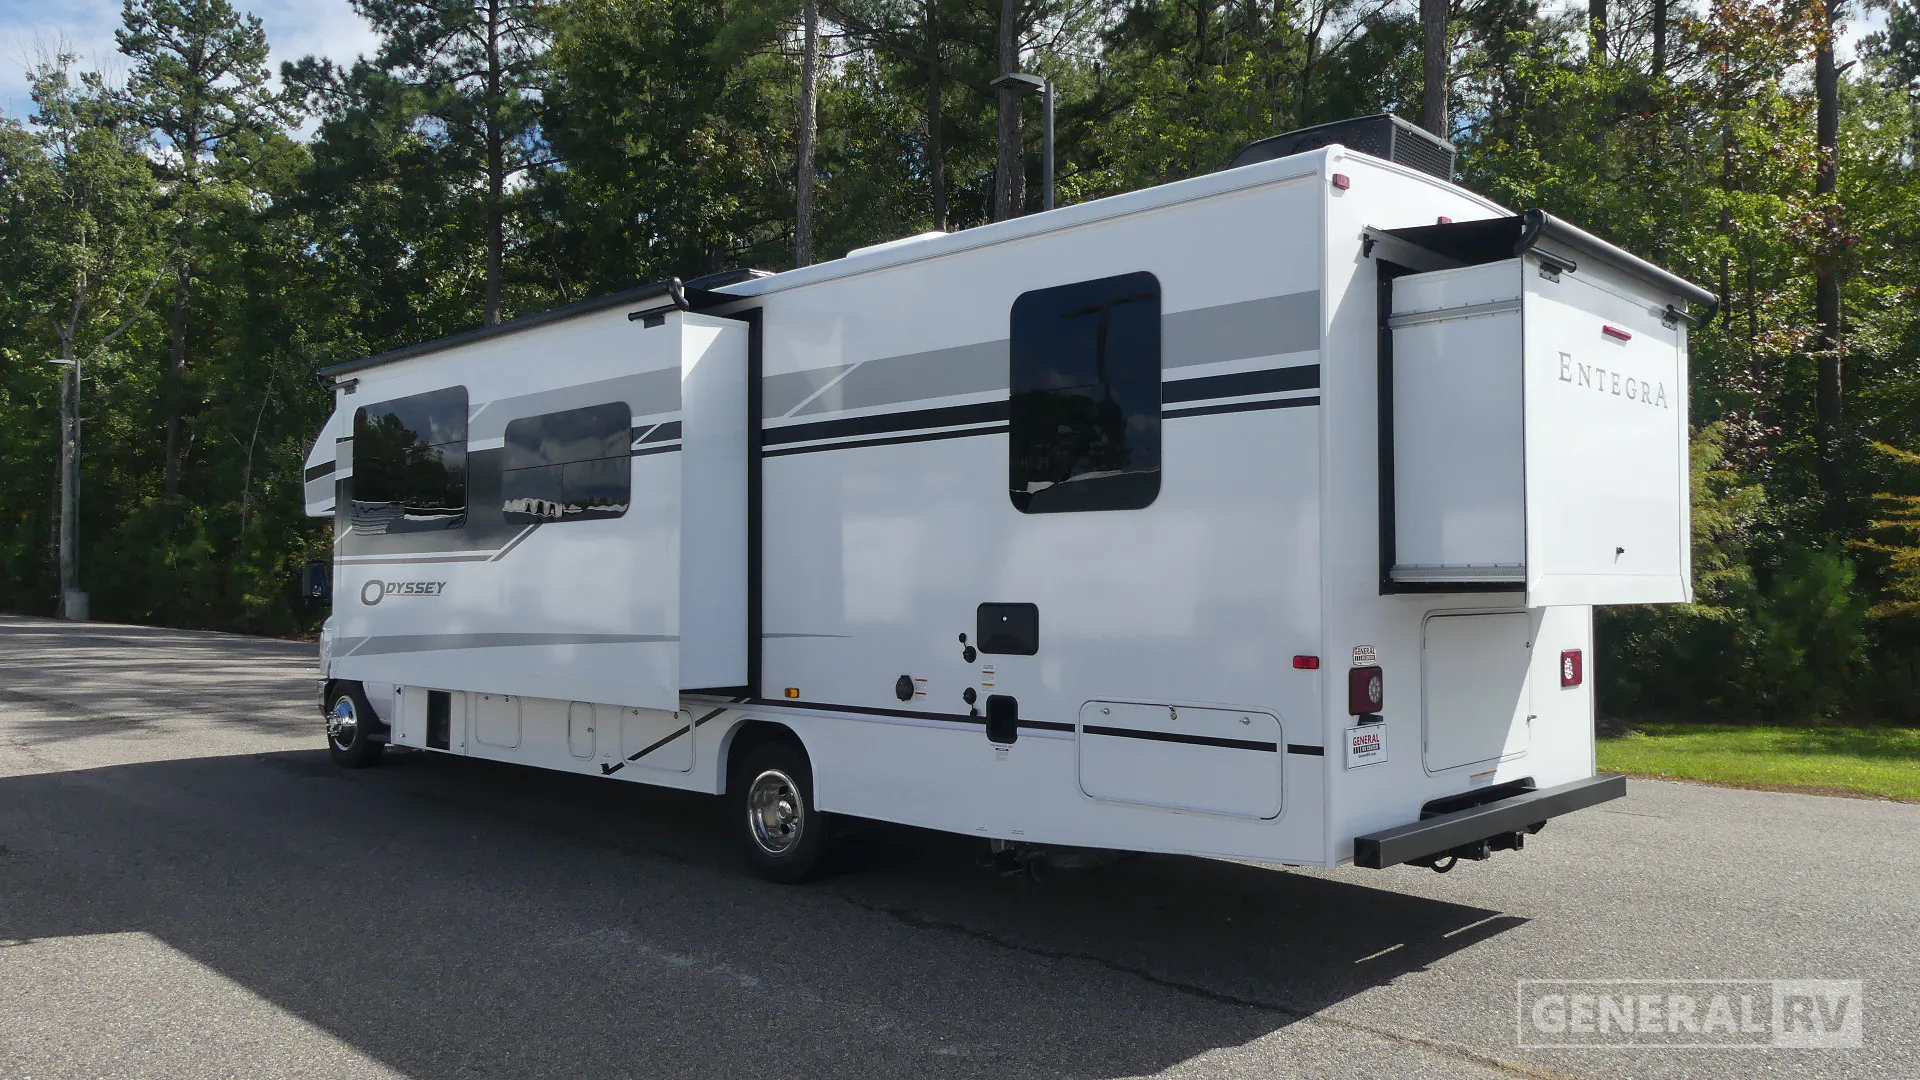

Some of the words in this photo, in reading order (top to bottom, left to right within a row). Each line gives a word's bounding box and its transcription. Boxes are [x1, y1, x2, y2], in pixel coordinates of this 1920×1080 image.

[1558, 351, 1668, 409] ENTEGRA
[361, 579, 447, 606] ODYSSEY
[1354, 647, 1376, 655] GENERAL
[1352, 733, 1380, 746] GENERAL
